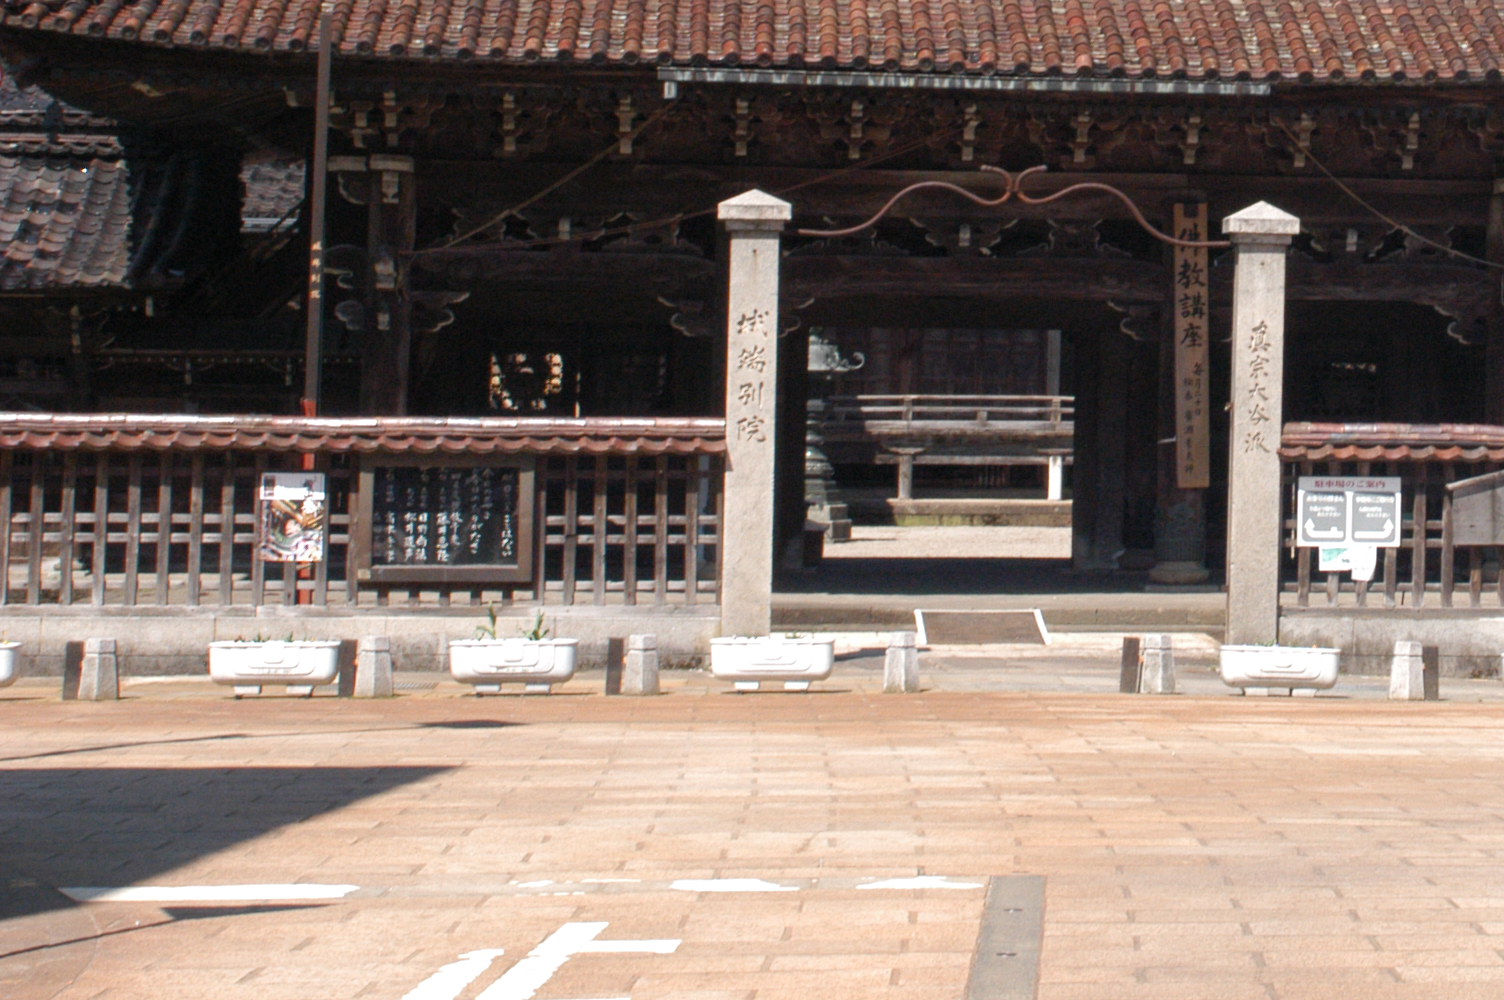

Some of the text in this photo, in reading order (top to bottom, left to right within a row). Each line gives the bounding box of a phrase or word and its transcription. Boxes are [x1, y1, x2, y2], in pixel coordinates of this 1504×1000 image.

[736, 308, 769, 443] 城端別院
[1314, 480, 1386, 489] 駐車場のご案内
